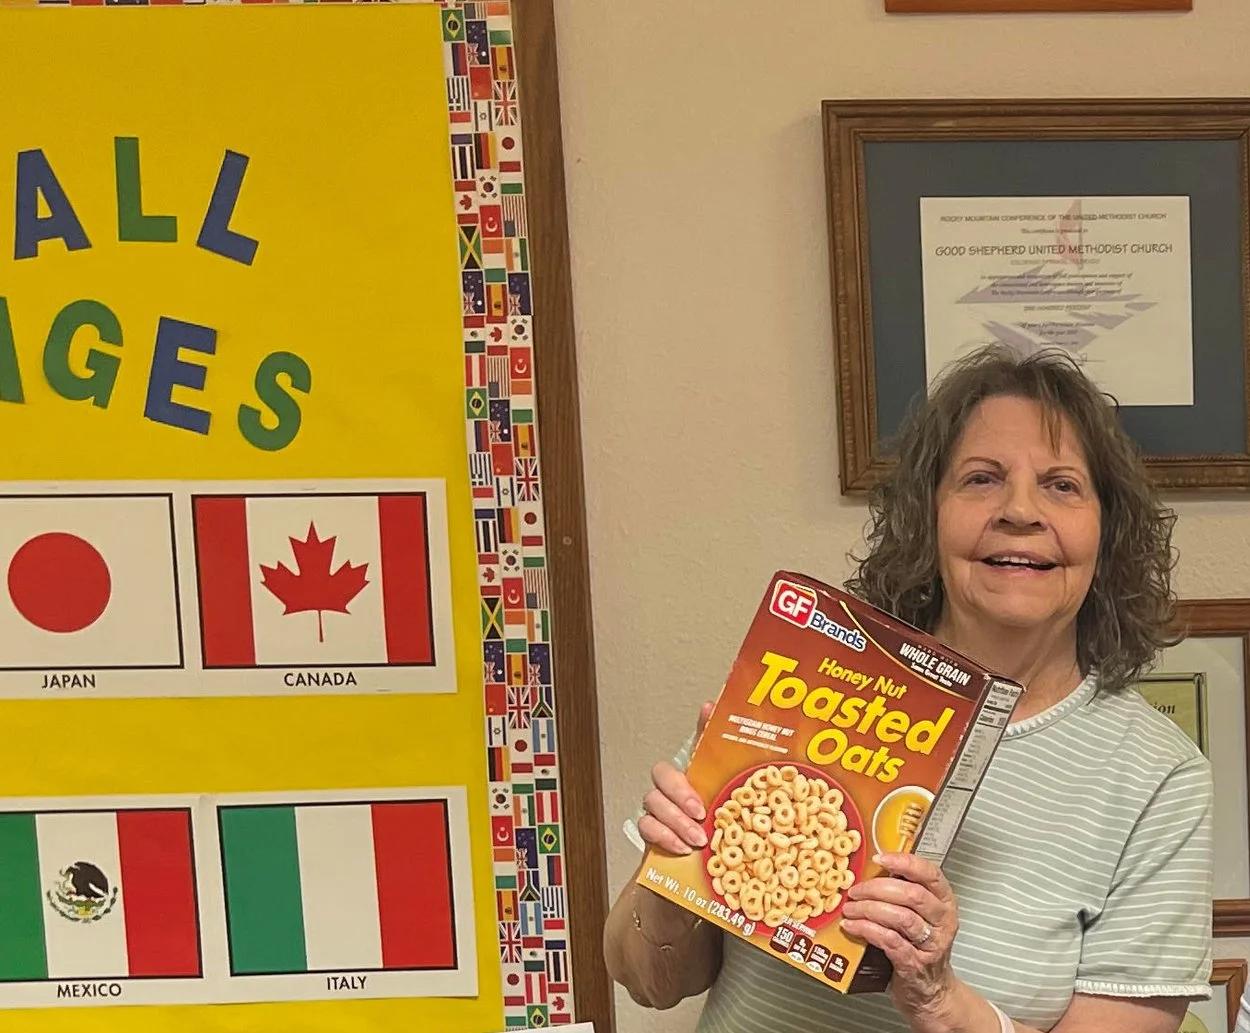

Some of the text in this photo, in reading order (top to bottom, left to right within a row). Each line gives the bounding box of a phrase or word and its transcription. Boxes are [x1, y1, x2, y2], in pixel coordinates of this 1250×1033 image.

[14, 137, 259, 266] ALL
[935, 243, 1173, 257] GOOD SHEPHERD UNITED METHODIST CHURCH
[778, 590, 866, 651] GF Brands
[42, 673, 96, 689] JAPAN
[283, 672, 358, 687] CANADA
[817, 657, 907, 700] Honey Nut
[899, 643, 972, 687] WHOLE GRAIN
[745, 651, 956, 756] Toasted
[806, 728, 906, 784] Oats
[646, 868, 663, 884] Net
[664, 876, 680, 895] Wt.
[683, 888, 697, 902] 10
[696, 897, 707, 909] oz
[708, 901, 745, 931] (283.49
[776, 926, 794, 943] 150
[57, 982, 122, 998] MEXICO
[326, 976, 367, 991] ITALY
